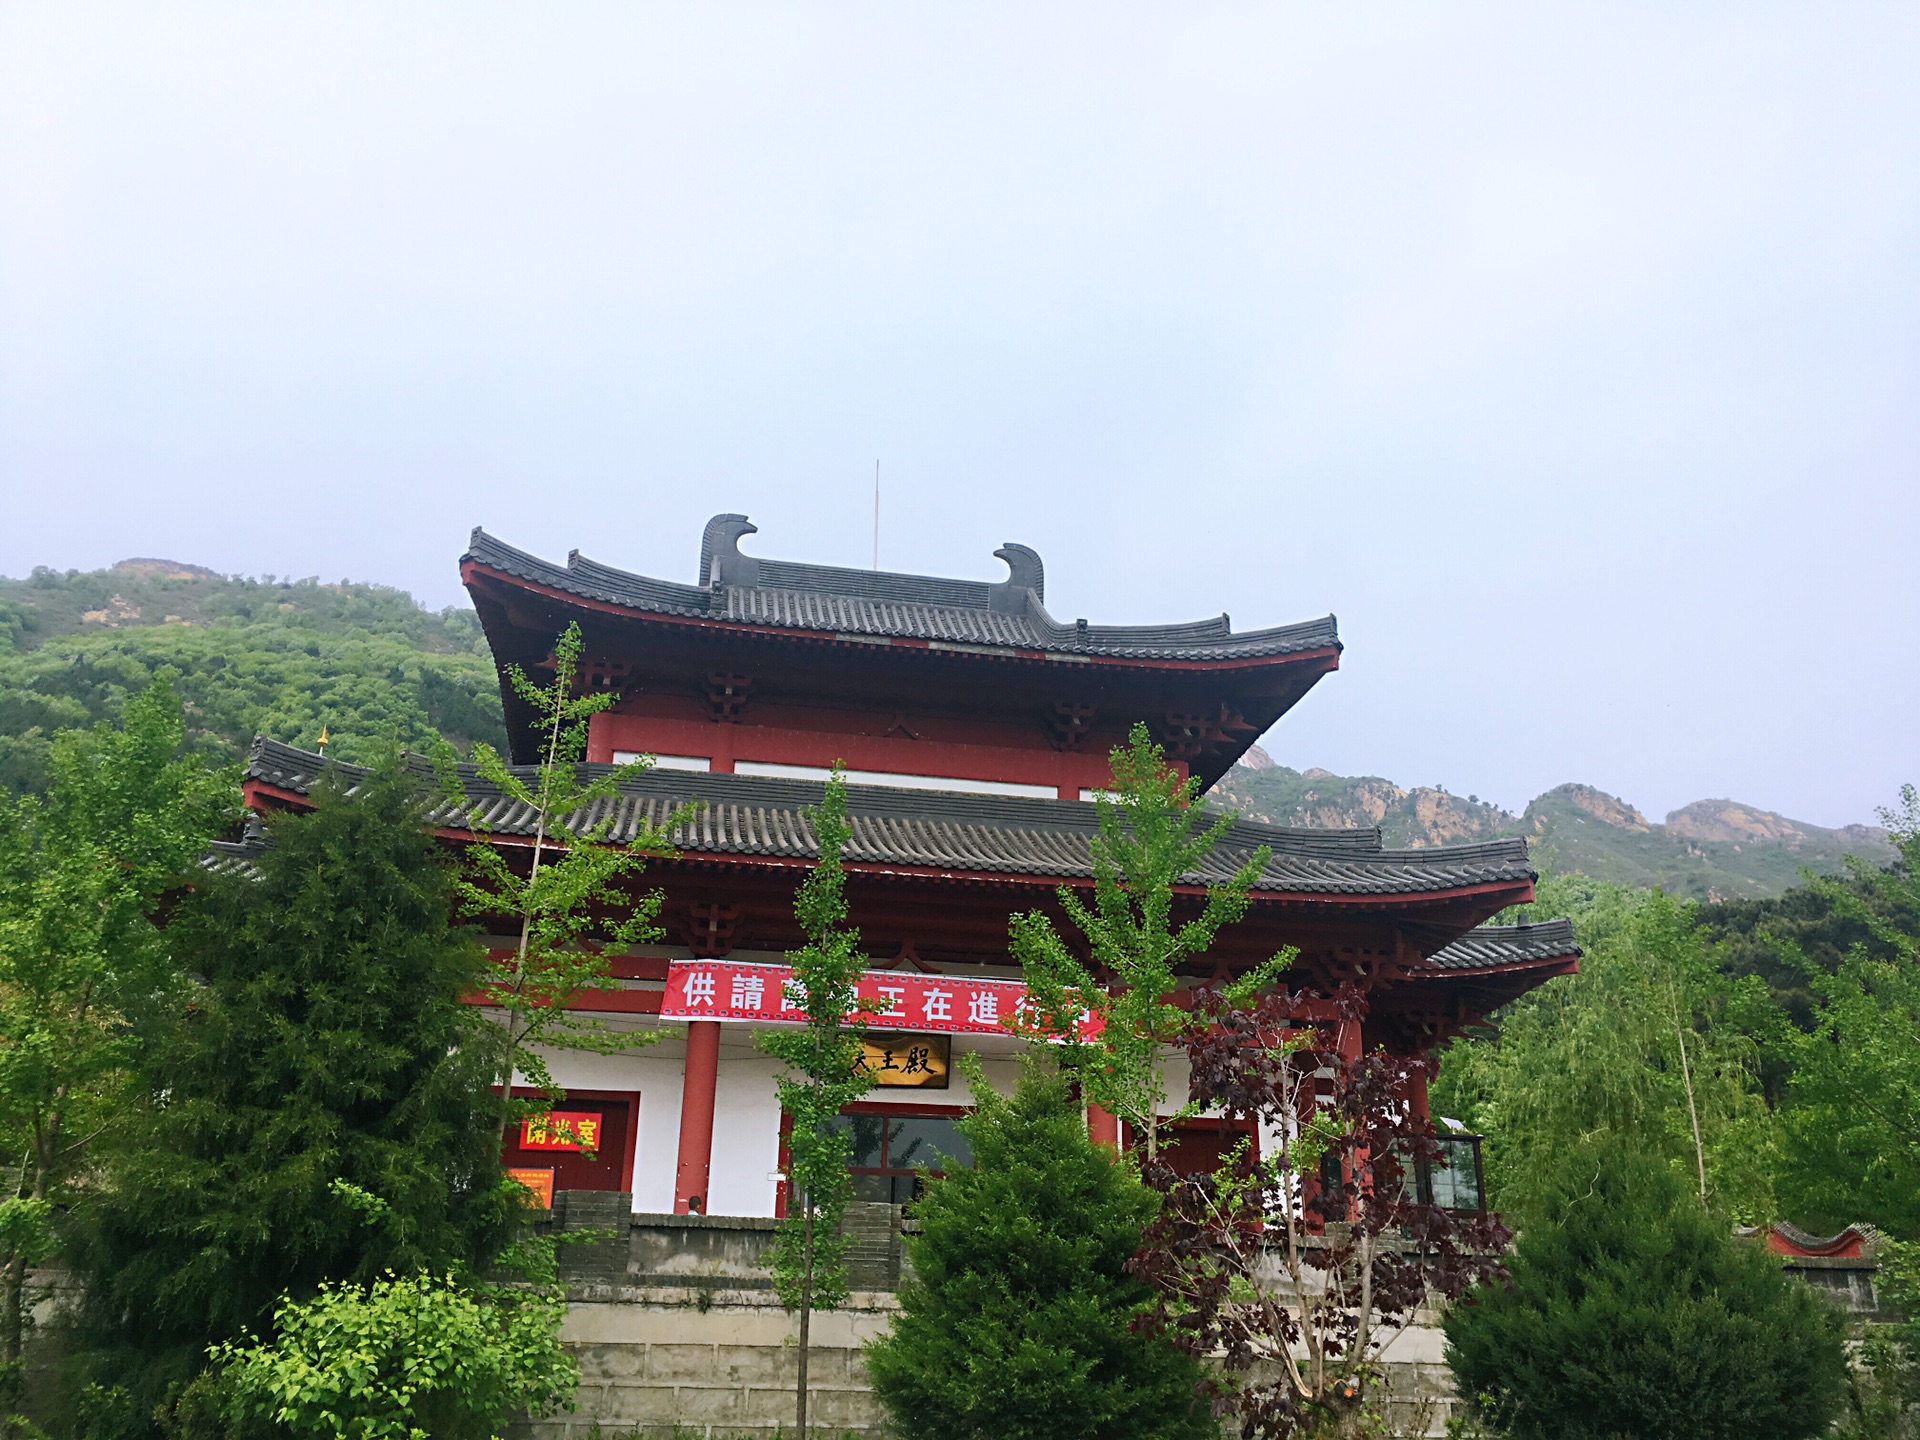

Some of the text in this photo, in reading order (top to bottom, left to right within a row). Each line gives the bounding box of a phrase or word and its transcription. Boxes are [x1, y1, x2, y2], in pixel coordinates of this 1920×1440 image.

[848, 1046, 938, 1075] 天王殿
[526, 1118, 597, 1146] 開光室
